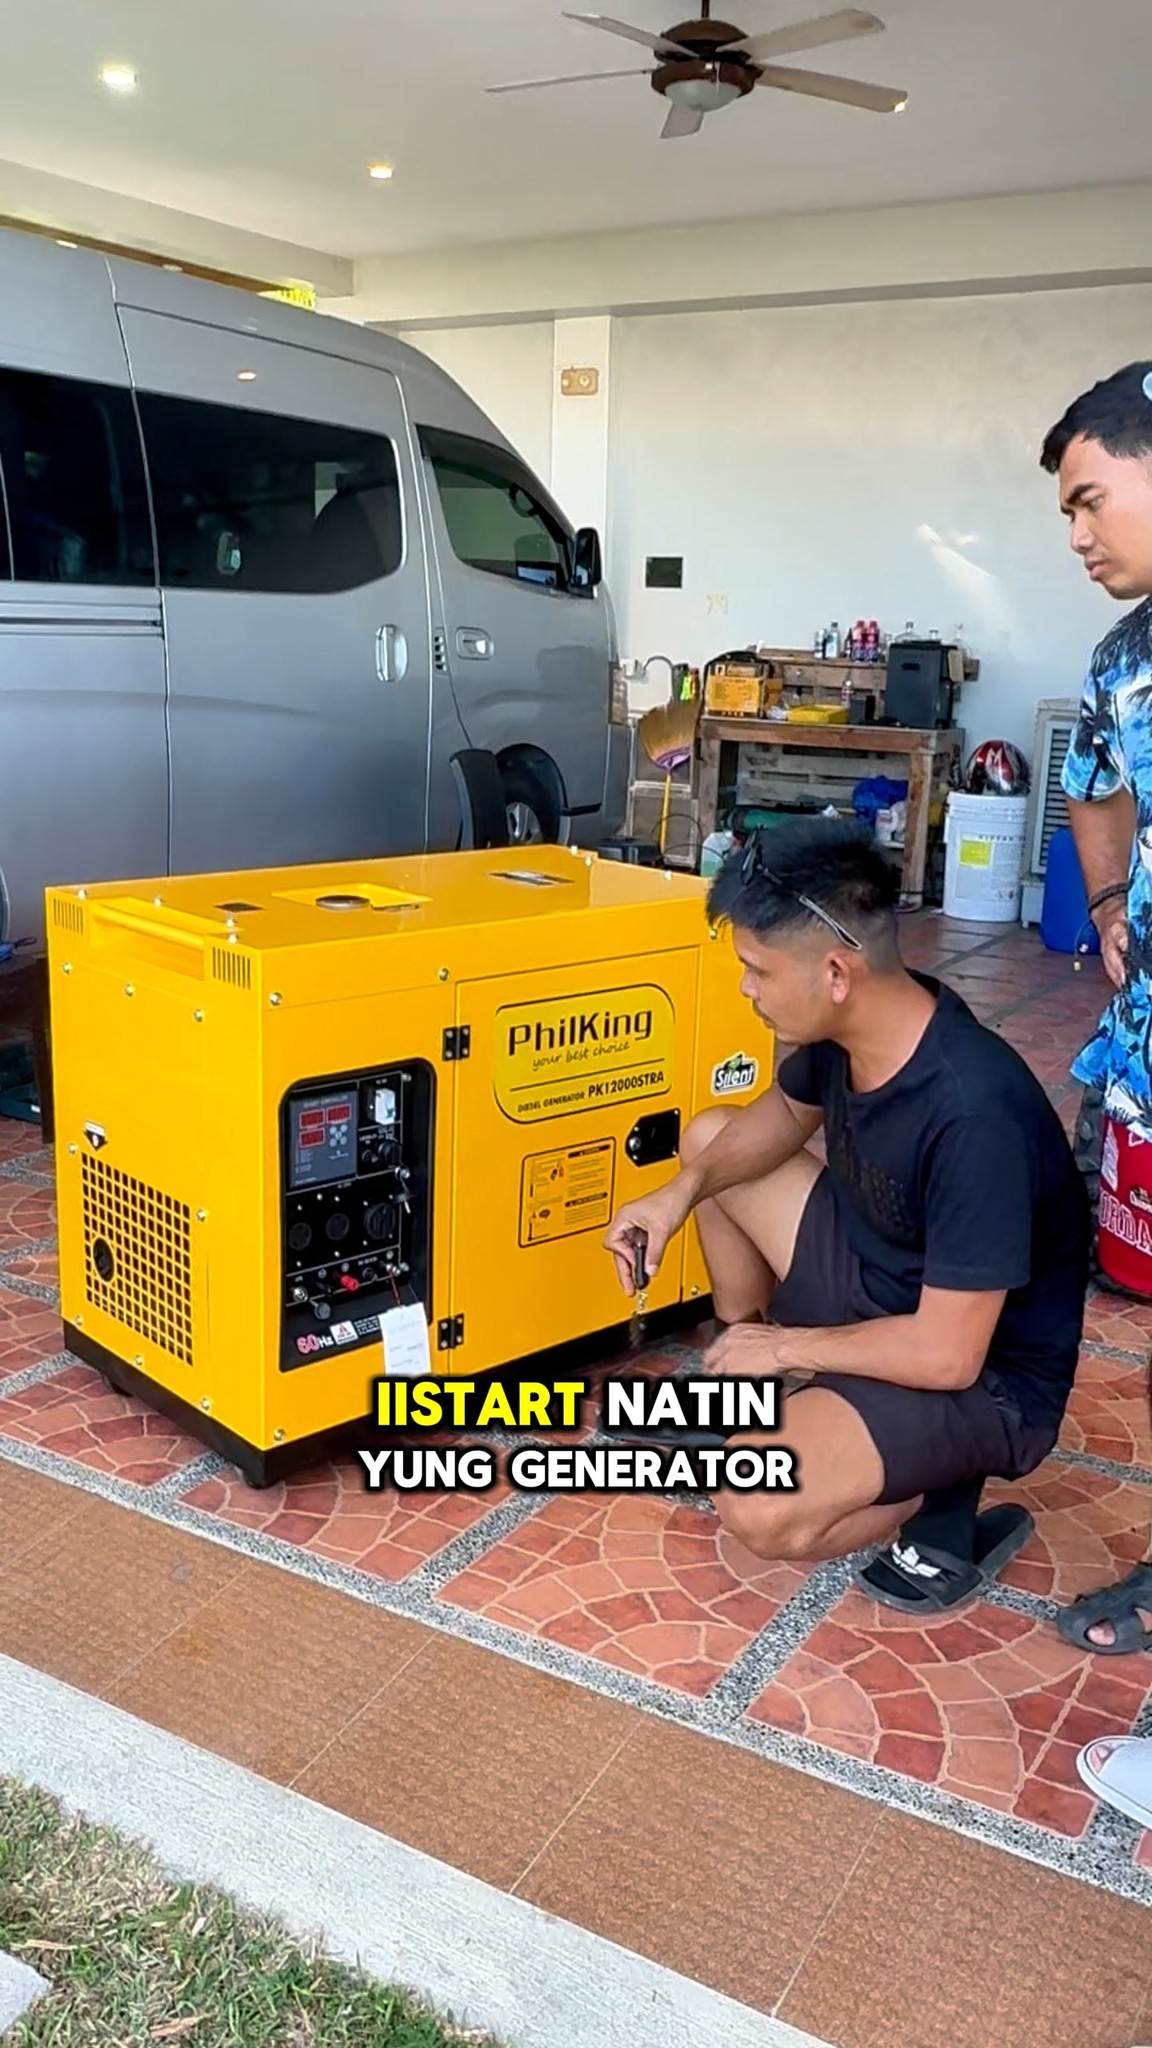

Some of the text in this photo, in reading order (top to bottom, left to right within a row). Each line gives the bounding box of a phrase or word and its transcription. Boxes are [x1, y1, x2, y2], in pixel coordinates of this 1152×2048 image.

[508, 1010, 652, 1056] PhilKing
[533, 1041, 630, 1071] your best choice
[517, 1071, 664, 1113] DIESEL GENERATOR PK12000STRA
[716, 1065, 754, 1089] Silent
[296, 1333, 334, 1354] 60Hz
